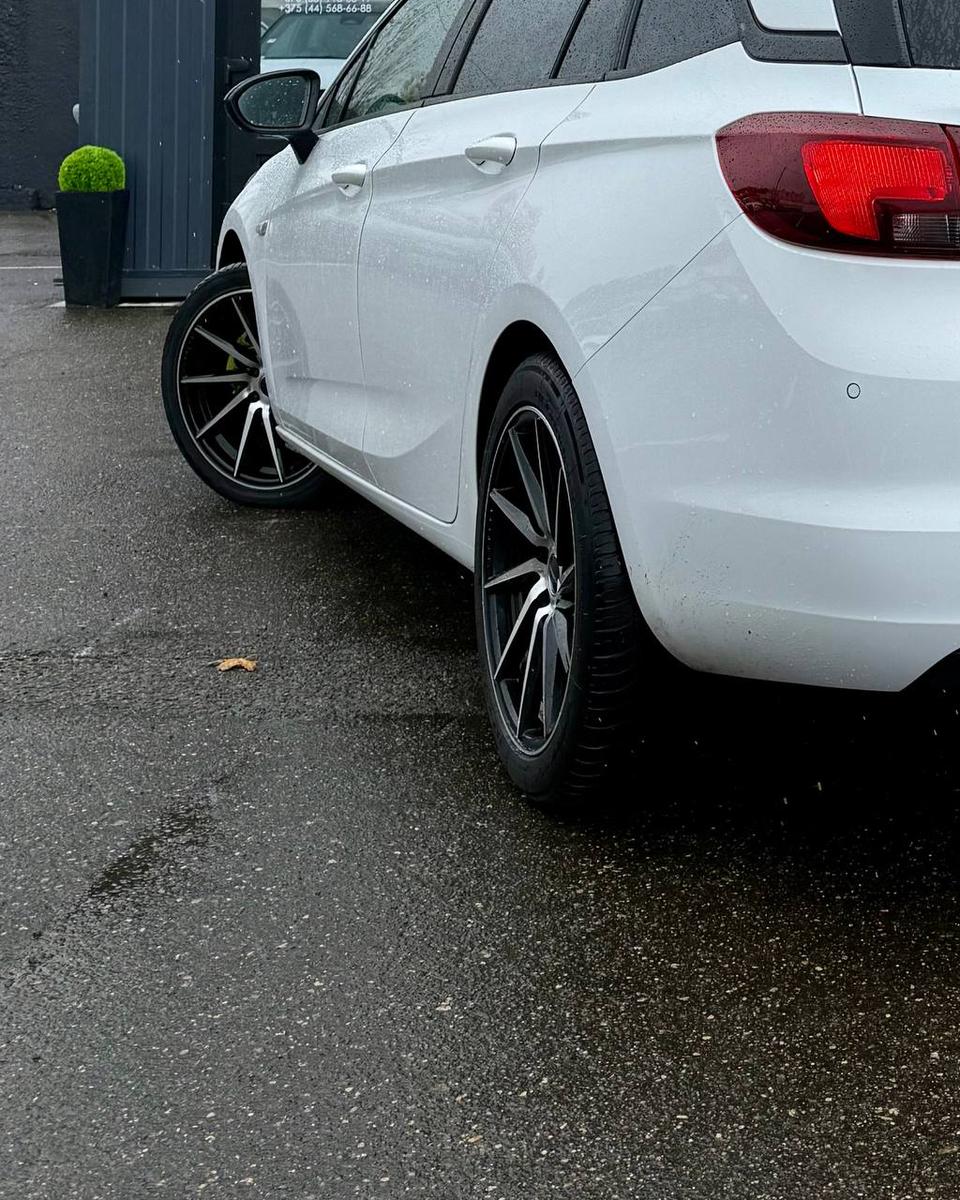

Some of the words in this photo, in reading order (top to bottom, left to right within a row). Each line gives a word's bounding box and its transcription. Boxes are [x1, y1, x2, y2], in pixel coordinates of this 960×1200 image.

[280, 4, 302, 14] +375
[305, 4, 322, 15] (44)
[325, 4, 372, 13] 568-66-88
